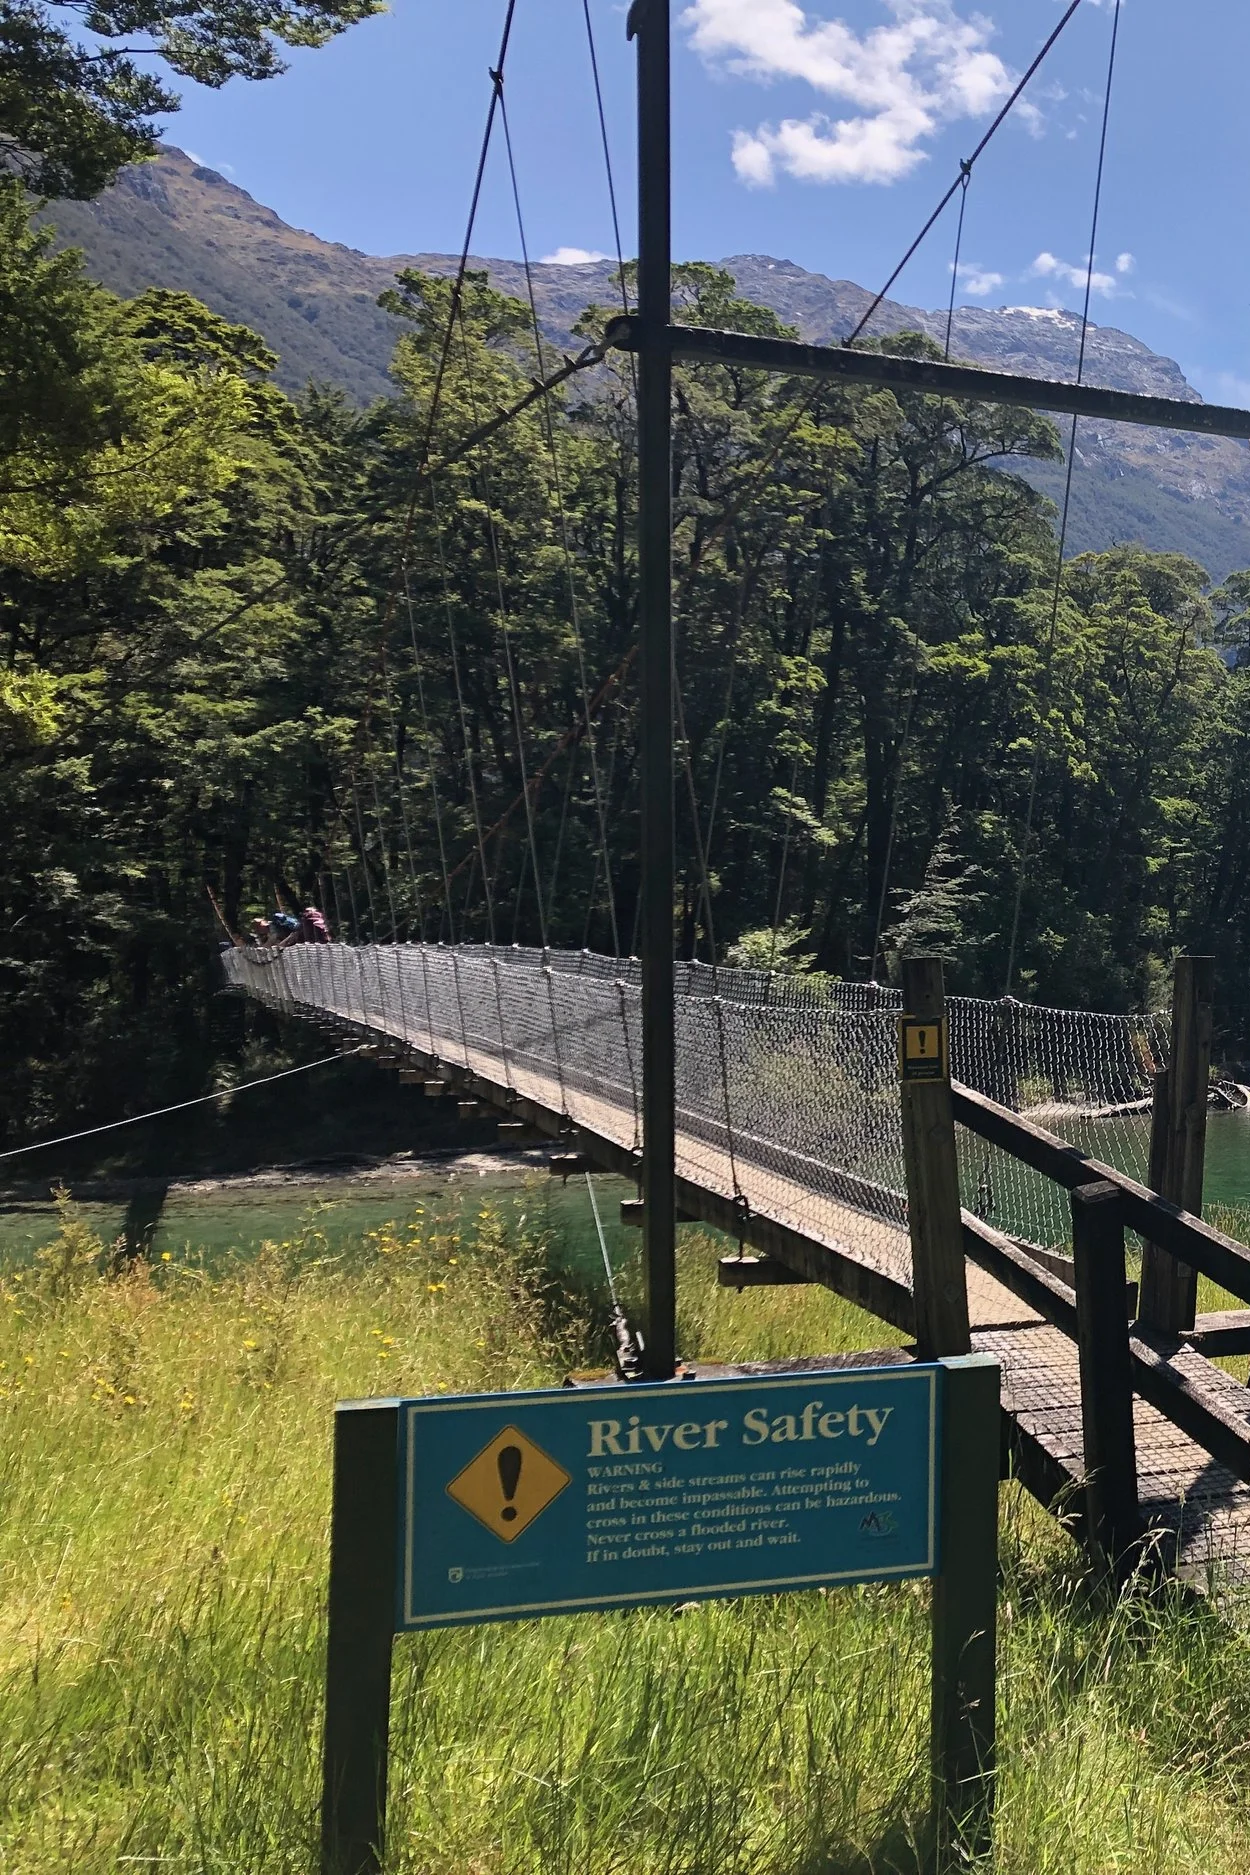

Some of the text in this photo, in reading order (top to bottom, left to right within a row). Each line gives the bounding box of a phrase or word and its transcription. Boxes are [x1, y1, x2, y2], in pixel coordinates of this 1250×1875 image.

[586, 1400, 894, 1457] River Safety
[587, 1462, 663, 1478] WARNING
[587, 1461, 861, 1496] Rivers & side streams can rise rapidly
[586, 1491, 901, 1529] cross in these conditions can be hazardous.
[587, 1478, 869, 1512] and become impassable. Attempting to
[586, 1532, 801, 1563] If in doubt, stay out and wait.
[587, 1517, 789, 1545] Never cross a flooded river.
